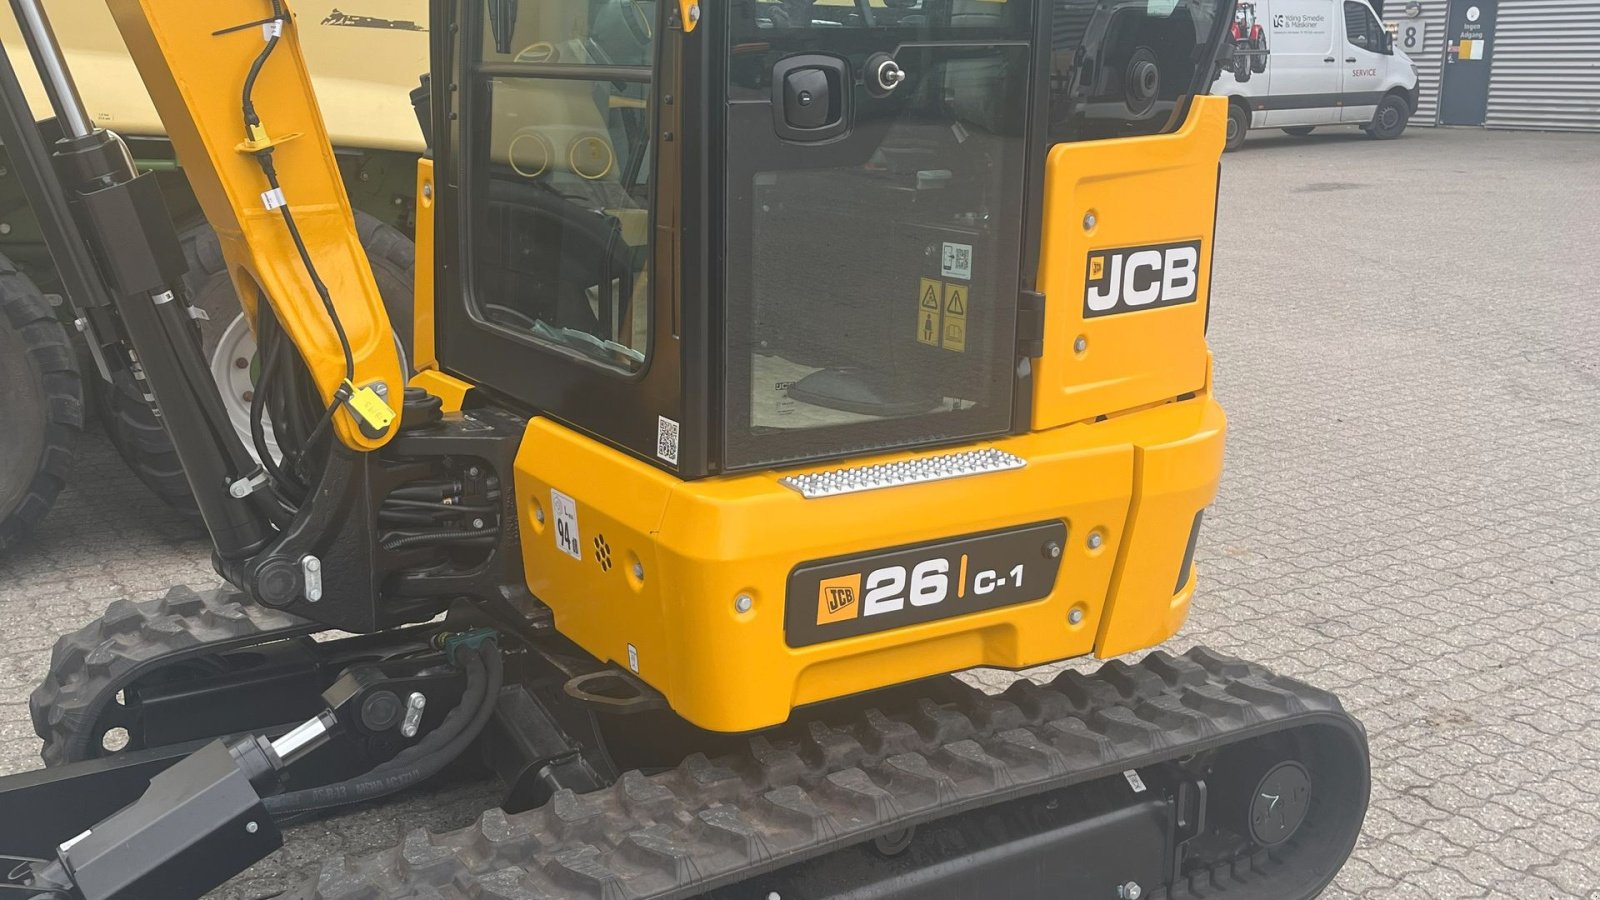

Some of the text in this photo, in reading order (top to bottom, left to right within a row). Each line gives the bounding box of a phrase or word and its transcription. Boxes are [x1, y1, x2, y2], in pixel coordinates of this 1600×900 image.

[1404, 26, 1416, 48] 8
[1460, 31, 1483, 39] Adgang
[1463, 23, 1481, 31] Ingen
[1352, 68, 1377, 77] SERVICE
[1087, 246, 1198, 311] JCB
[557, 517, 571, 550] 94
[827, 557, 1024, 617] JCB 26 C-1
